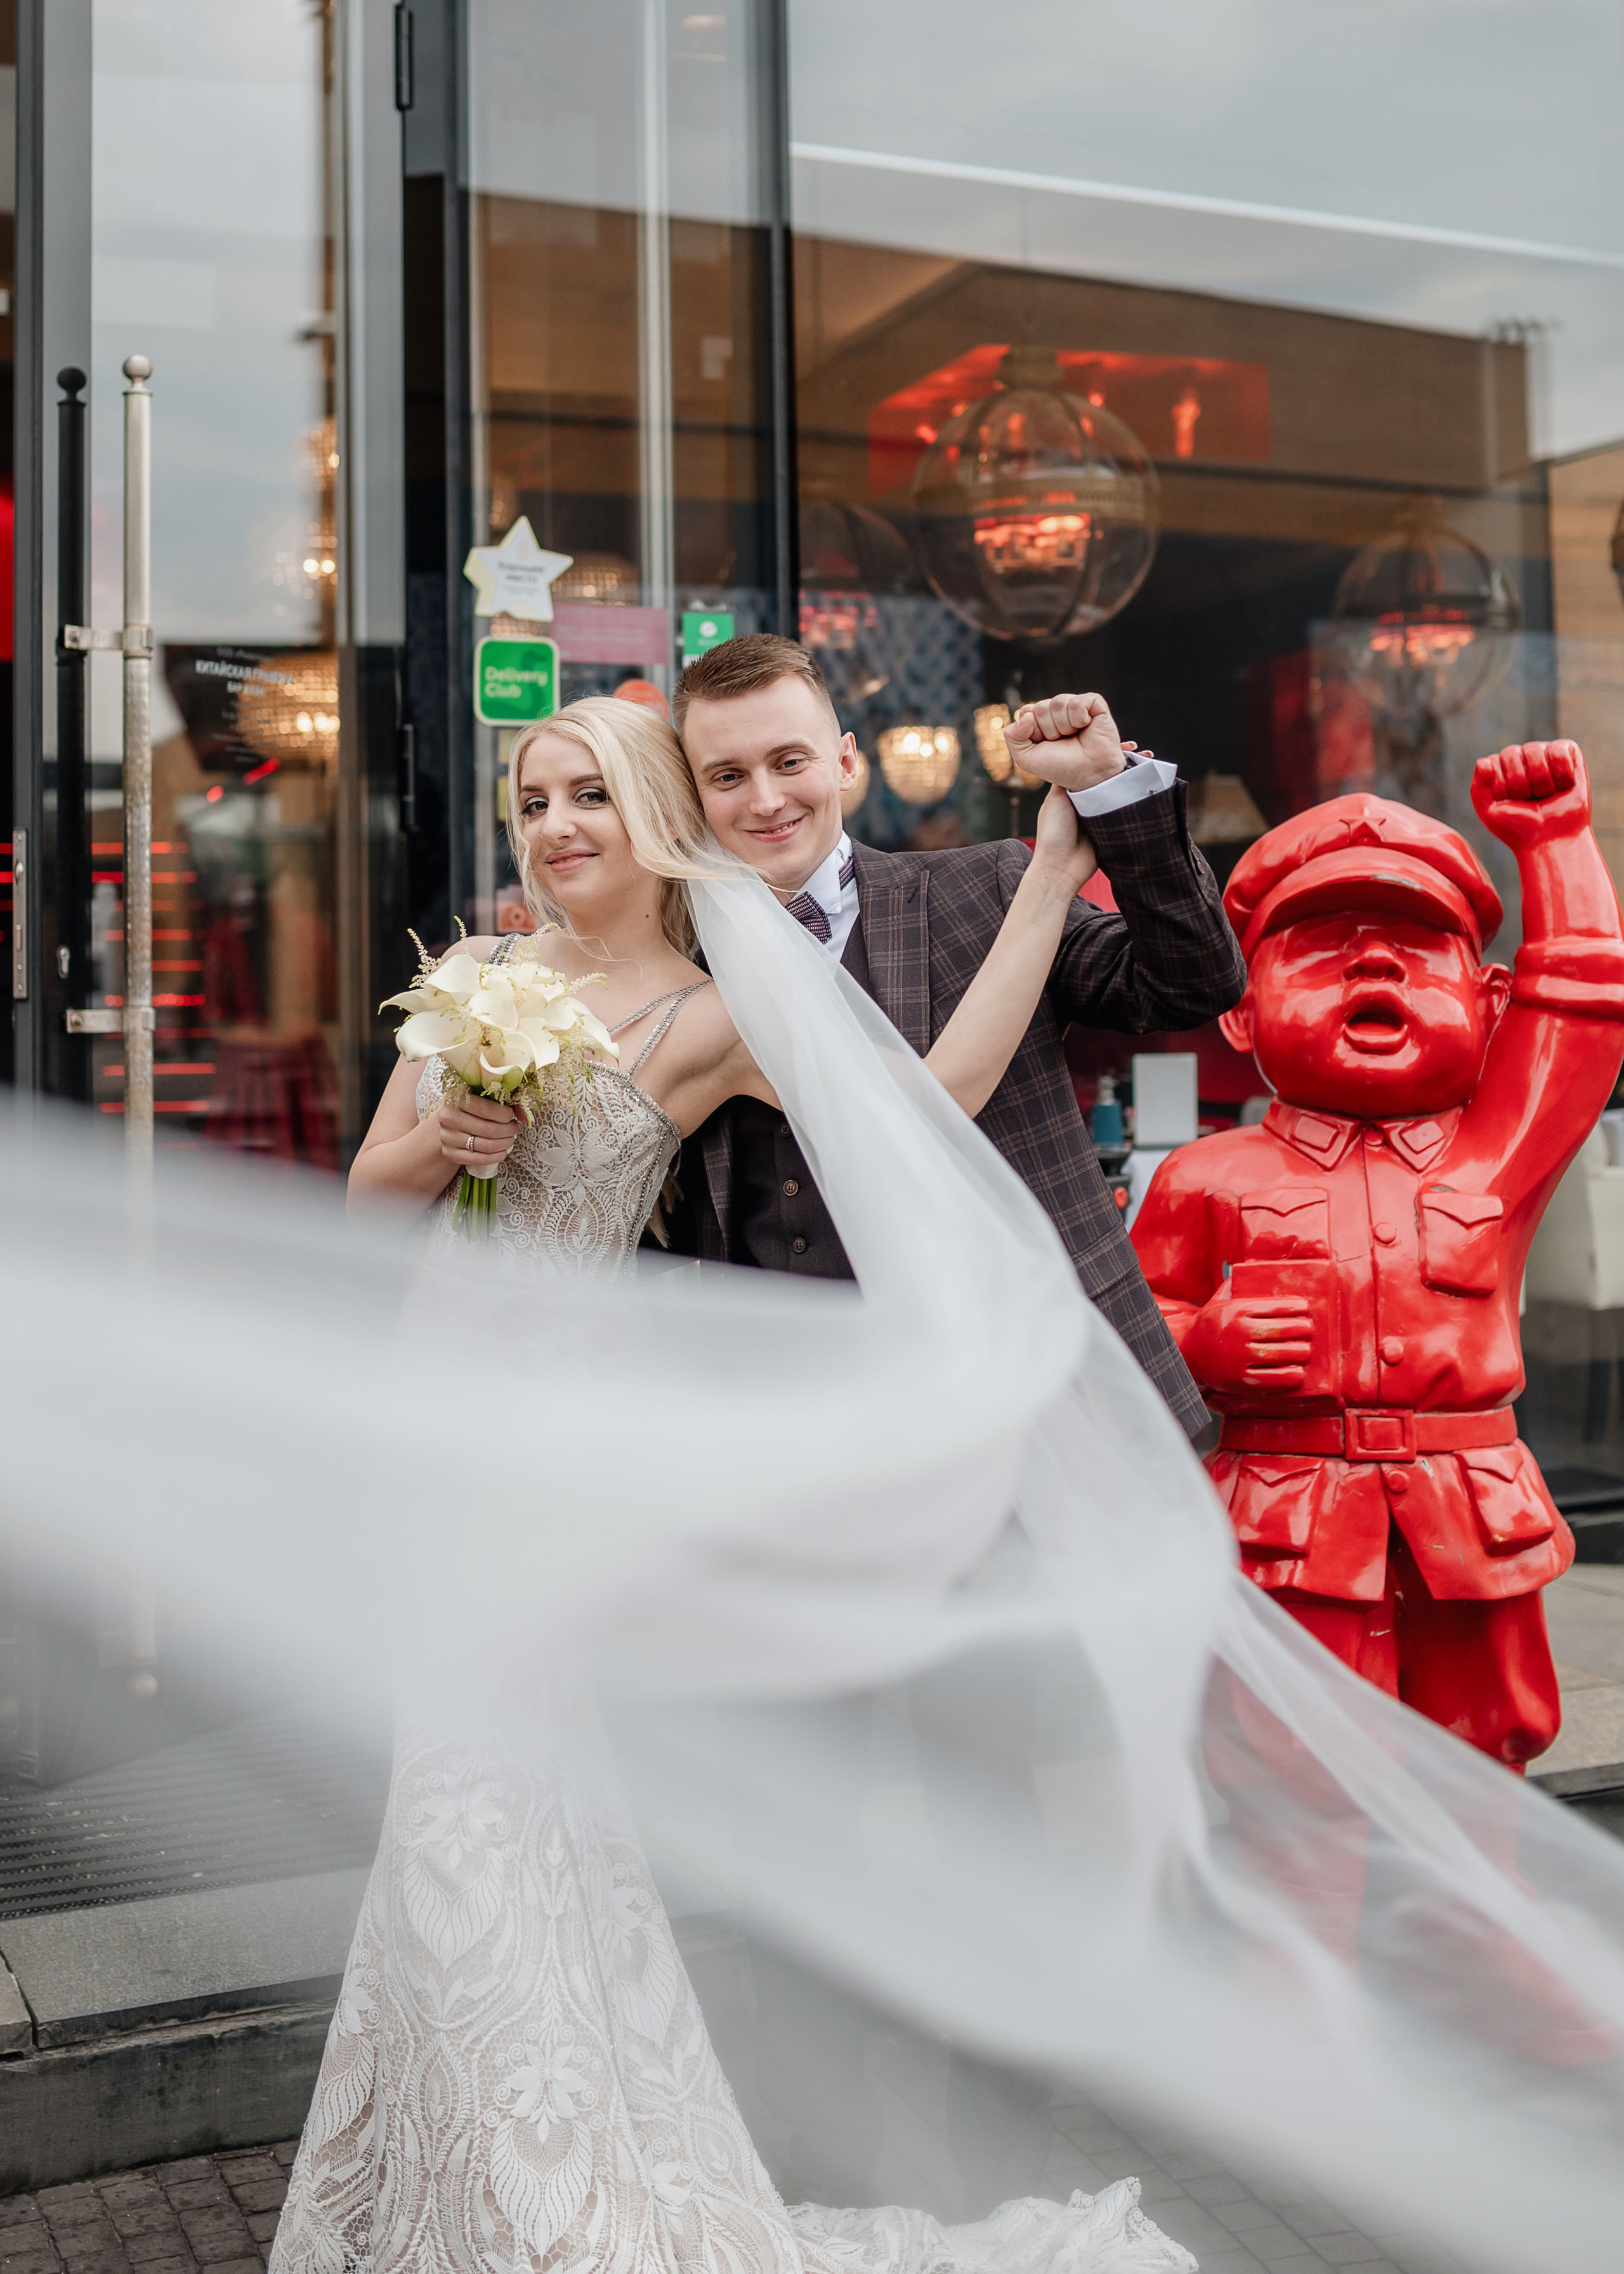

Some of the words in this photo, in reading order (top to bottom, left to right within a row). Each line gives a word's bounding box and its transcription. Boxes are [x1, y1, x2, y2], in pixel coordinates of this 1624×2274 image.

[195, 659, 252, 680] КИТАЙСКАЯ
[485, 666, 548, 687] Delivery
[484, 682, 521, 698] Club
